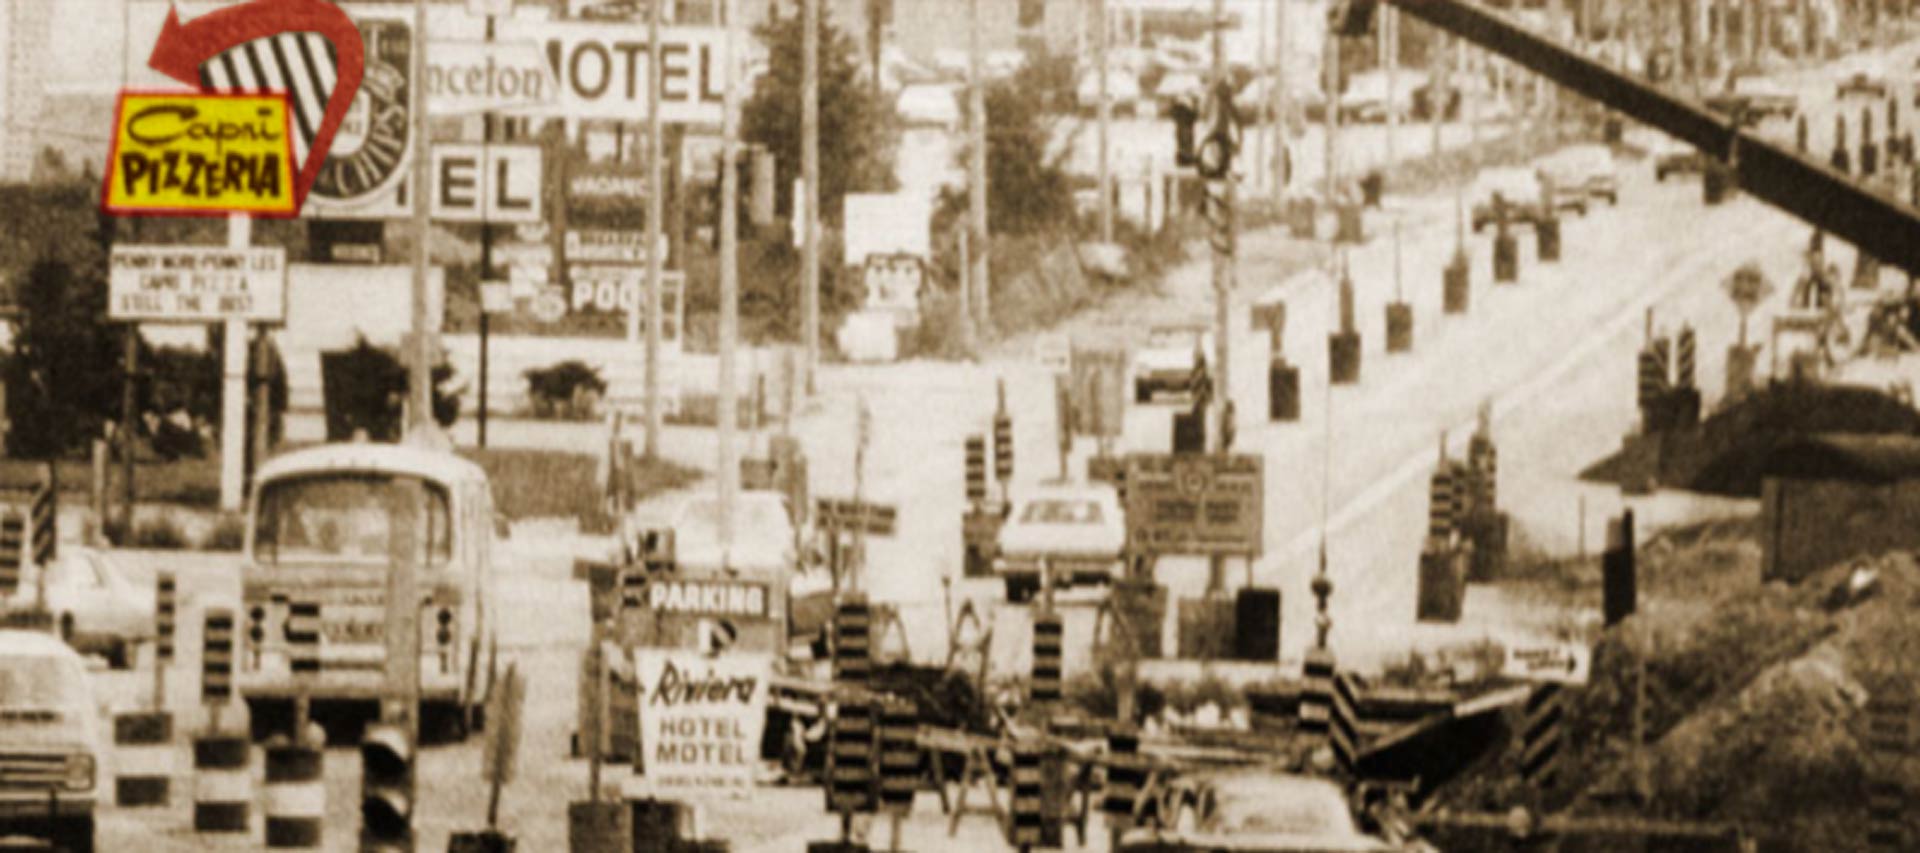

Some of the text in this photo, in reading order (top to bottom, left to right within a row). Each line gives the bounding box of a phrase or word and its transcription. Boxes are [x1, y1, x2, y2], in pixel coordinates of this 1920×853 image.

[426, 55, 543, 98] nceton
[127, 105, 281, 155] Capri
[122, 152, 280, 198] PIZZERIA
[441, 157, 532, 208] EL
[571, 176, 652, 198] VACANC
[573, 280, 644, 312] POO
[651, 581, 764, 615] PARKING
[651, 659, 757, 706] Riviera
[659, 718, 744, 739] HOTEL
[656, 743, 746, 766] MOTEL
